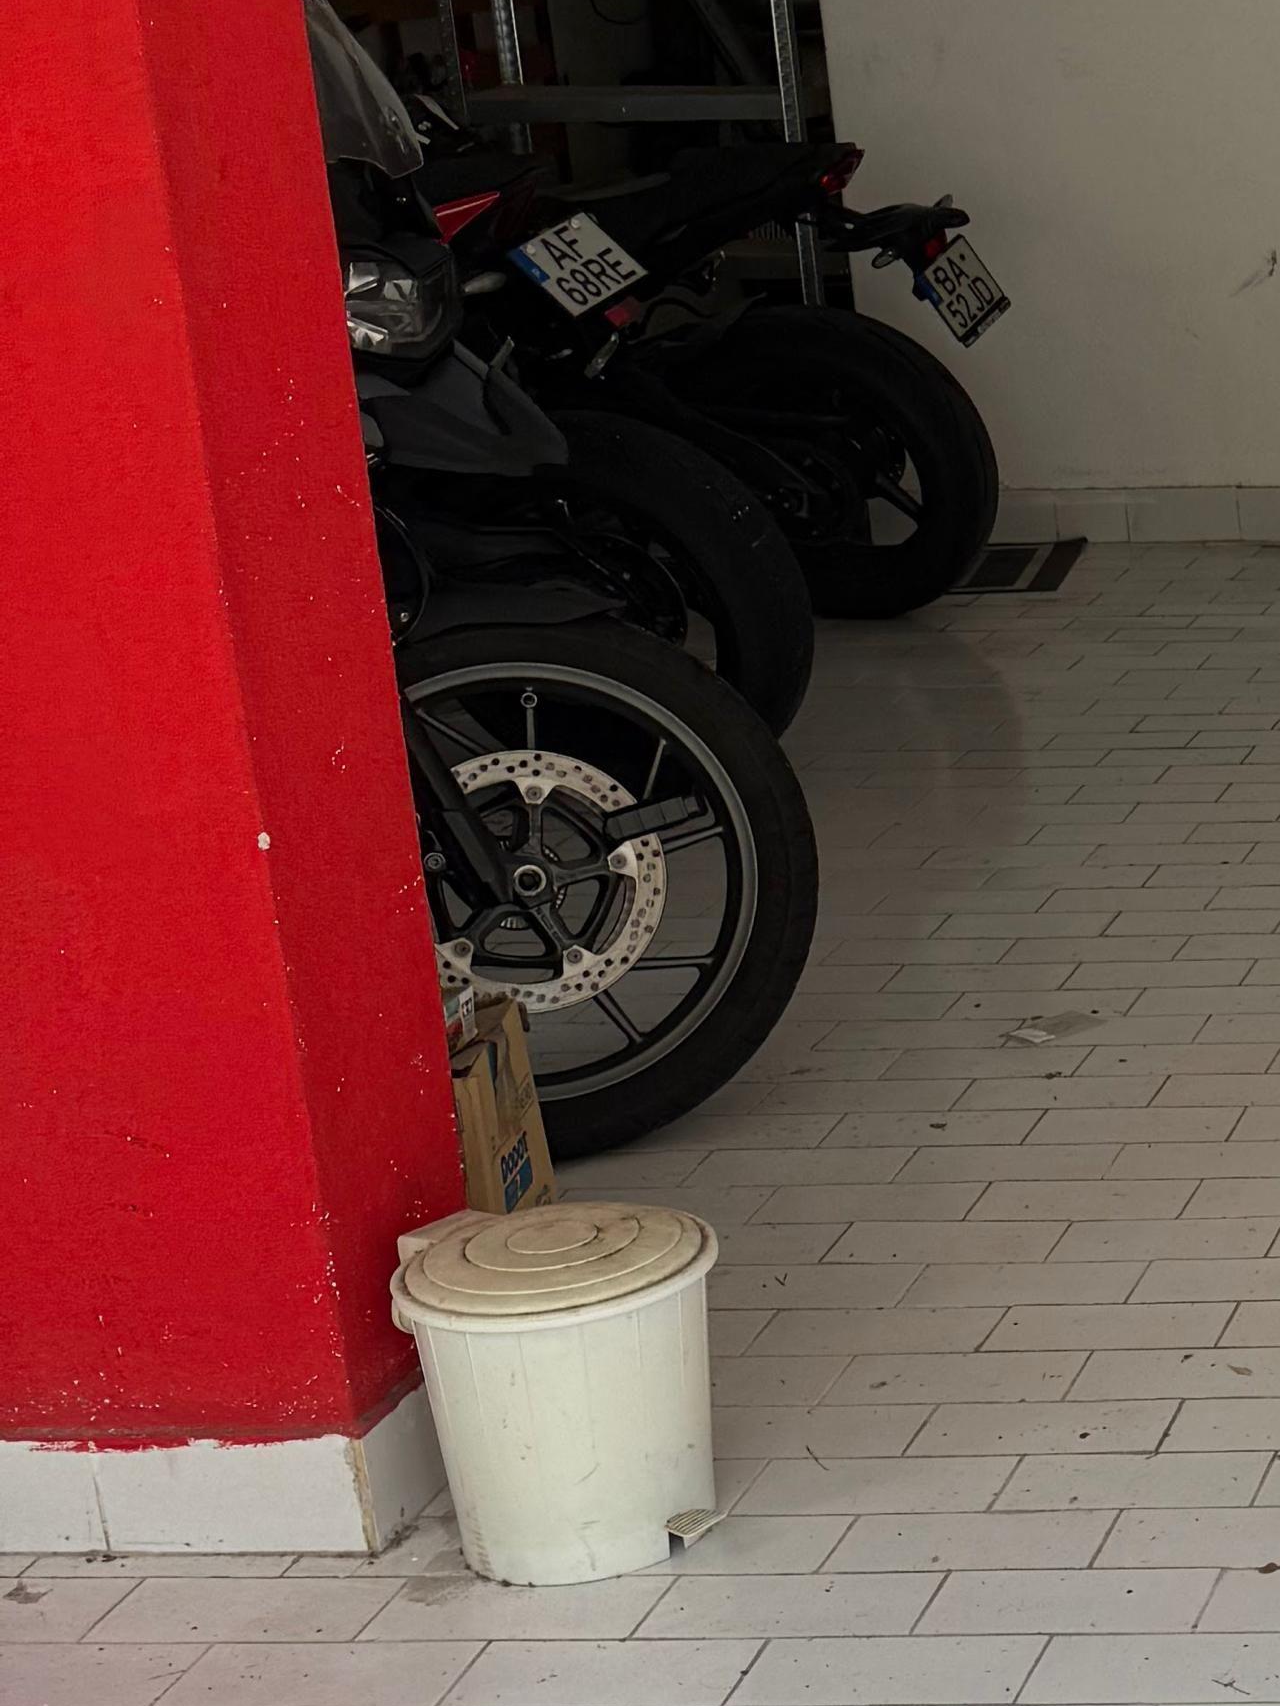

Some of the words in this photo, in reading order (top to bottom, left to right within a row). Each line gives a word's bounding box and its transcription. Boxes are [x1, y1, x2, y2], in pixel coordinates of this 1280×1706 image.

[541, 225, 583, 270] AF
[556, 247, 636, 306] 68RE
[932, 257, 969, 296] BA
[946, 277, 994, 329] 52JD
